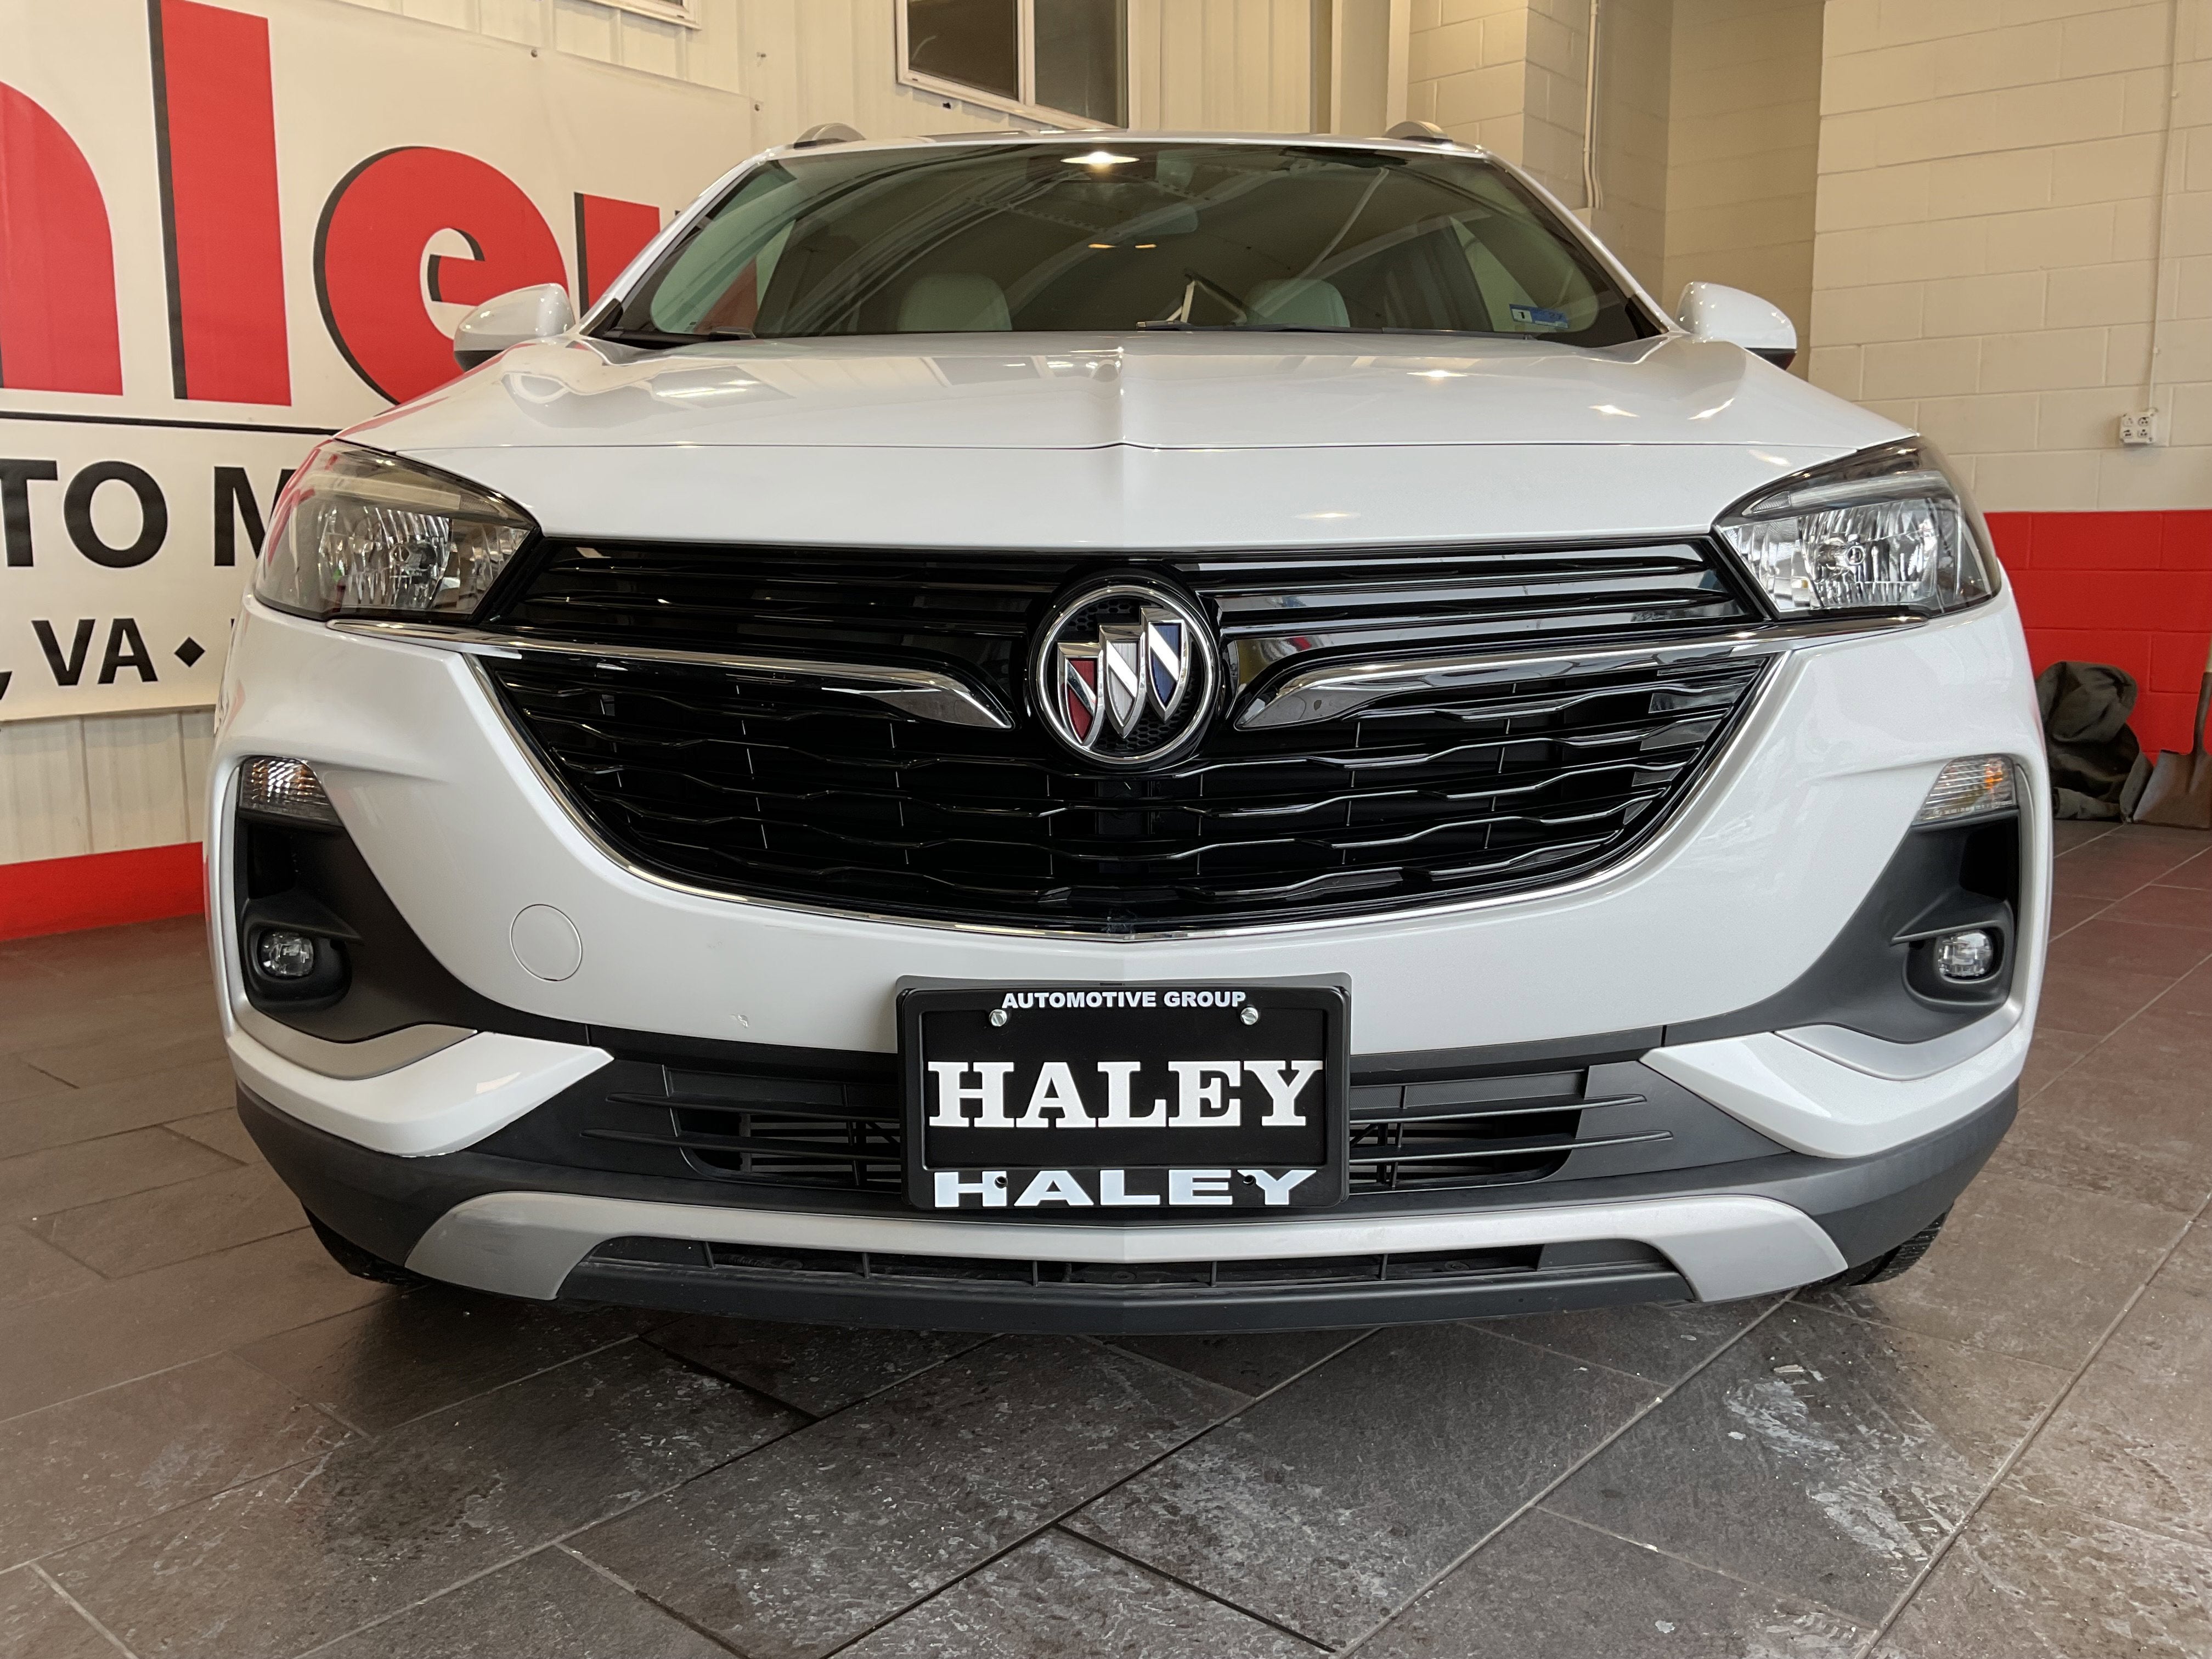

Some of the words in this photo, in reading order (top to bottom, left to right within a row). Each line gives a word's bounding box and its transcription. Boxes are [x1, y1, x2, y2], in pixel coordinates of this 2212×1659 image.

[1001, 992, 1156, 1009] AUTOMOTIVE
[1164, 991, 1246, 1008] GROUP
[928, 1061, 1323, 1127] HALEY
[934, 1169, 1317, 1207] HALEY
